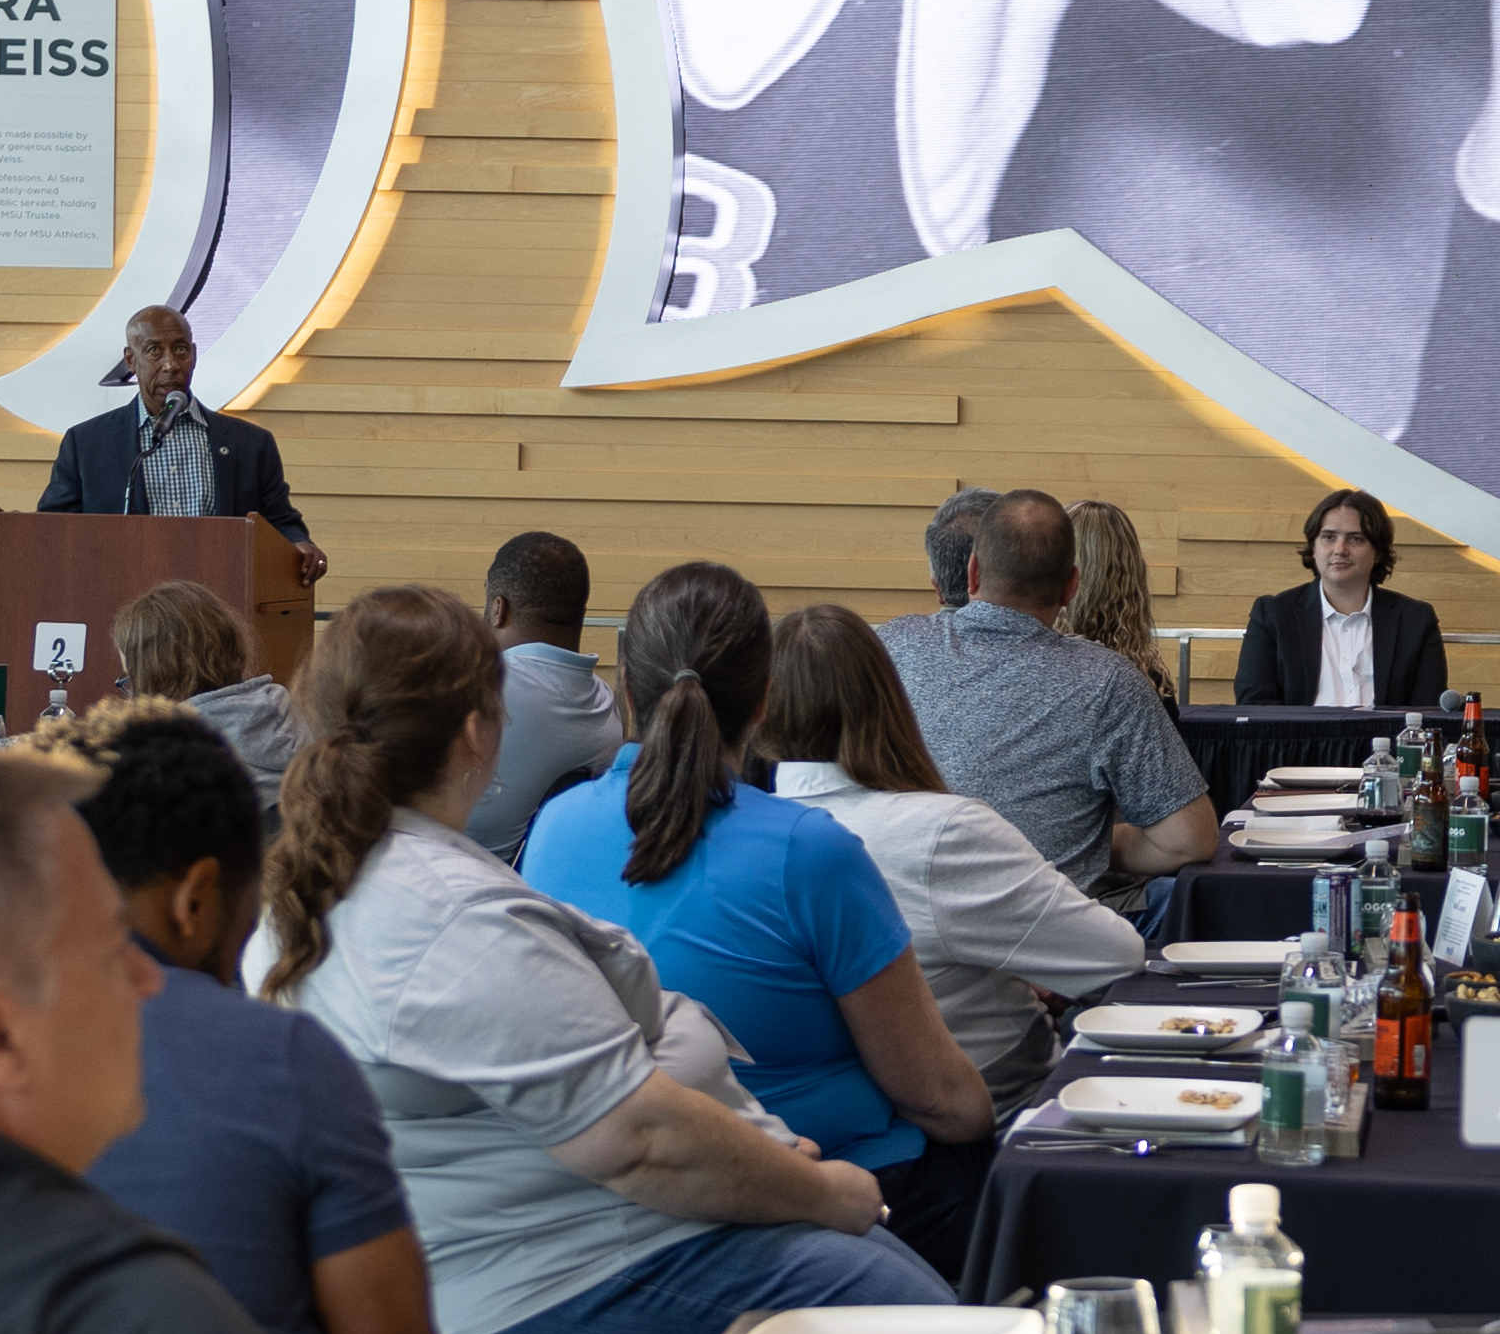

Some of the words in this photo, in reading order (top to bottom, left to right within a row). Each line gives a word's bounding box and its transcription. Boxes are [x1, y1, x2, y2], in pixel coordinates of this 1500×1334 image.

[5, 129, 32, 139] made
[34, 130, 74, 142] possible
[76, 131, 88, 142] by
[7, 144, 52, 153] generous
[55, 143, 92, 154] support
[47, 173, 57, 182] Al
[59, 174, 85, 183] Serra
[20, 198, 58, 209] servant,
[60, 199, 96, 210] holding
[1, 210, 23, 219] MSU
[25, 210, 63, 220] Trustee.
[52, 637, 66, 668] 2
